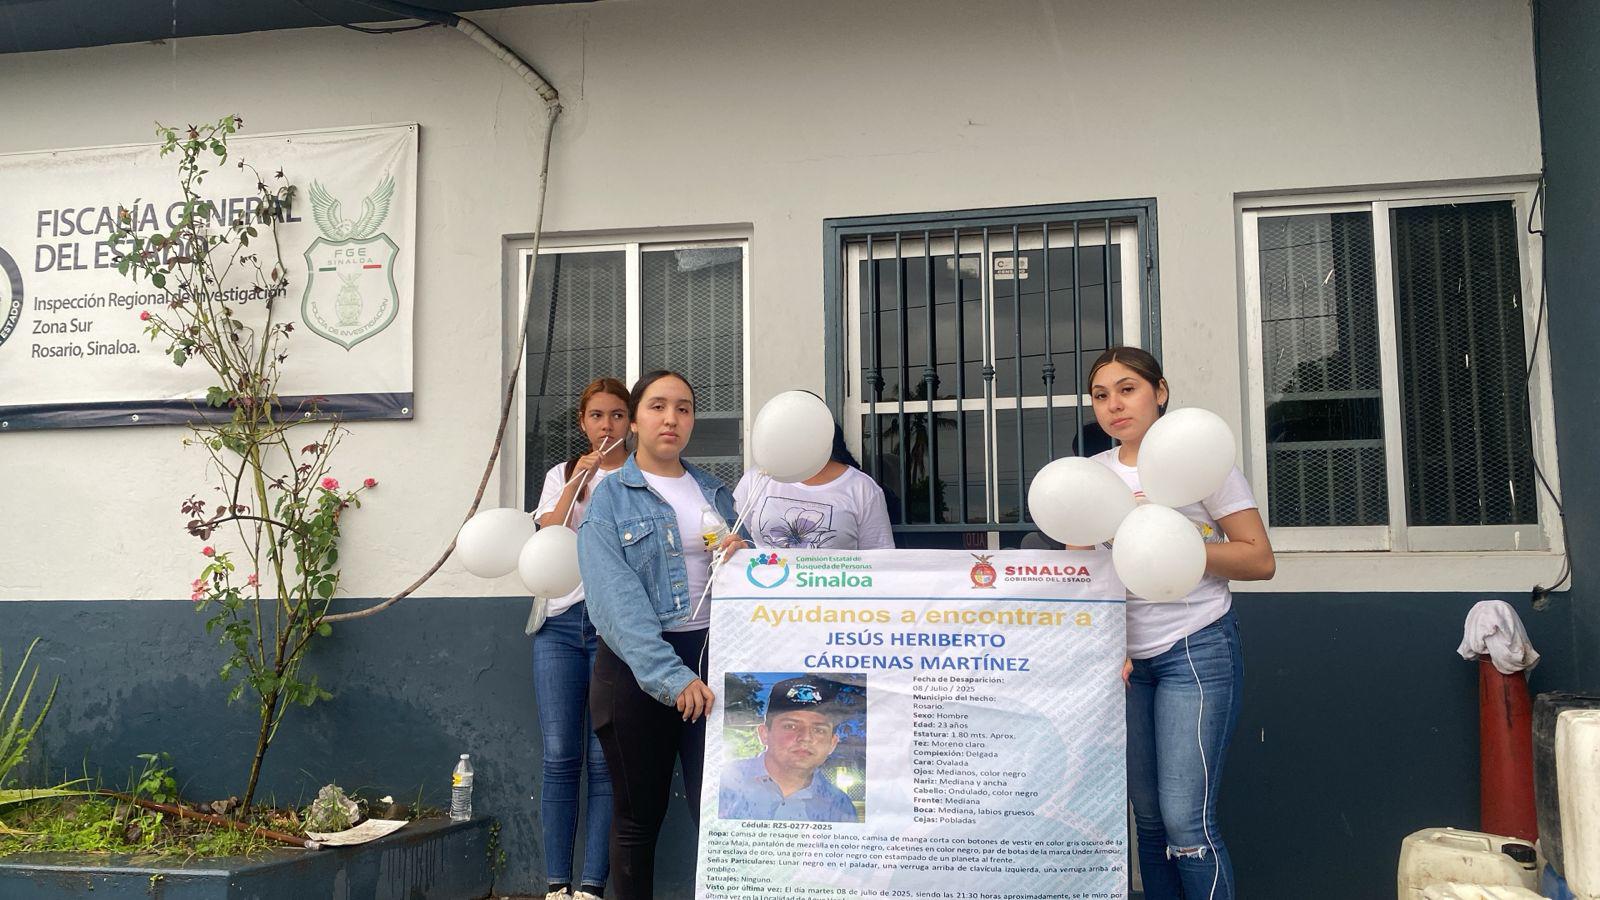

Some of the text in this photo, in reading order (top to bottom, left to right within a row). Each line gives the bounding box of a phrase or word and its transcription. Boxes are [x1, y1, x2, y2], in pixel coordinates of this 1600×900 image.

[35, 242, 88, 272] DEL
[334, 248, 367, 258] FGE
[33, 293, 106, 313] Inspección
[108, 291, 169, 310] Regional
[0, 300, 20, 338] ESTADO
[32, 318, 93, 334] Zona Sur
[31, 339, 140, 359] Rosario, Sinaloa.
[1005, 566, 1090, 577] SINALOA
[796, 572, 873, 588] Sinaloa
[751, 605, 1093, 627] Ayúdanos a encontrar a
[825, 629, 1006, 648] JESÚS HERIBERTO
[804, 651, 1030, 672] CÁRDENAS MARTÍNEZ
[949, 677, 1005, 685] Desaparición:
[913, 694, 953, 702] Municipio
[913, 750, 998, 759] Complexión: Delgada
[937, 769, 978, 777] Medianos,
[948, 788, 990, 796] Ondulado,
[938, 807, 976, 815] Mediana,
[913, 816, 938, 824] Cejas:
[708, 830, 728, 838] Ropa:
[884, 854, 926, 862] estampado
[952, 856, 979, 864] planeta
[849, 861, 880, 869] paladar,
[1005, 866, 1041, 874] izquierda,
